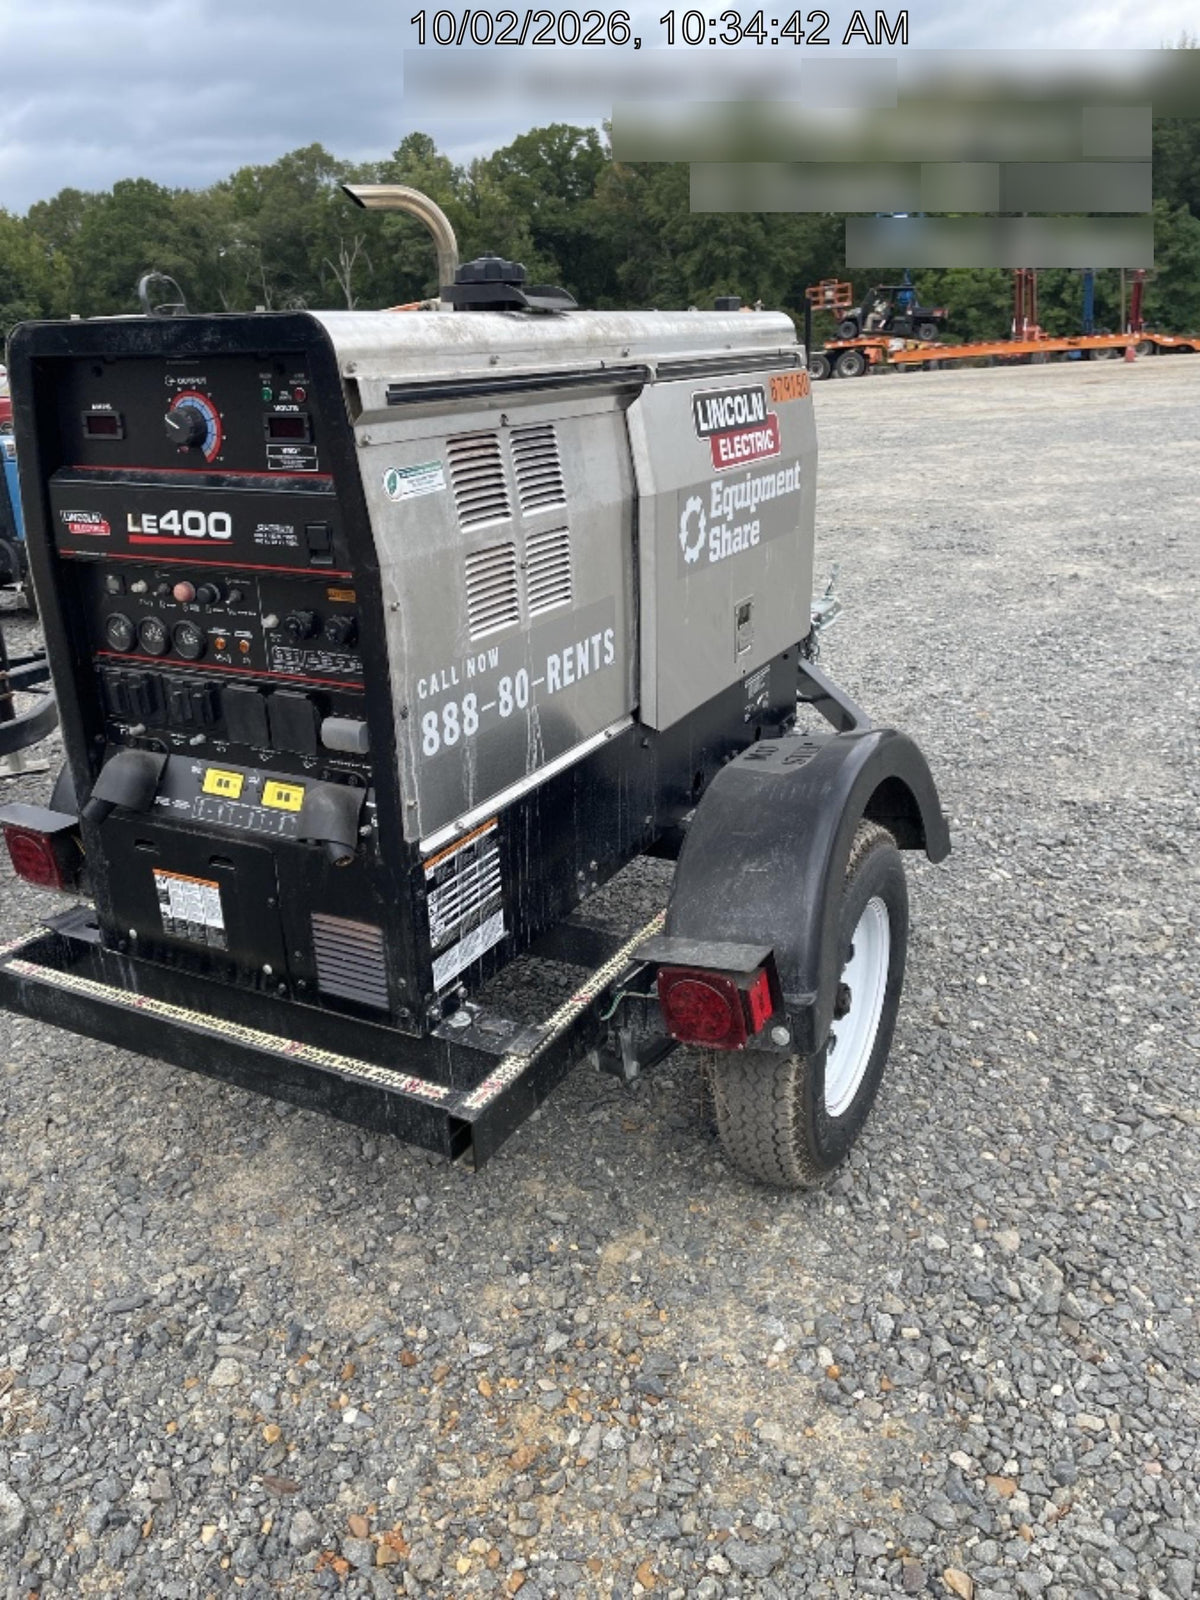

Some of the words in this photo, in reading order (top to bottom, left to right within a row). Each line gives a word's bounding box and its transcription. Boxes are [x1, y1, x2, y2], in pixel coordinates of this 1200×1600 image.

[697, 391, 766, 431] LINCOLN
[719, 428, 775, 461] ELECTRIC
[710, 460, 800, 521] Equipment
[127, 509, 233, 540] LE400
[708, 518, 761, 563] Share
[416, 665, 460, 700] CALL
[466, 646, 500, 679] NOW
[421, 627, 616, 757] 888-80-RENTS
